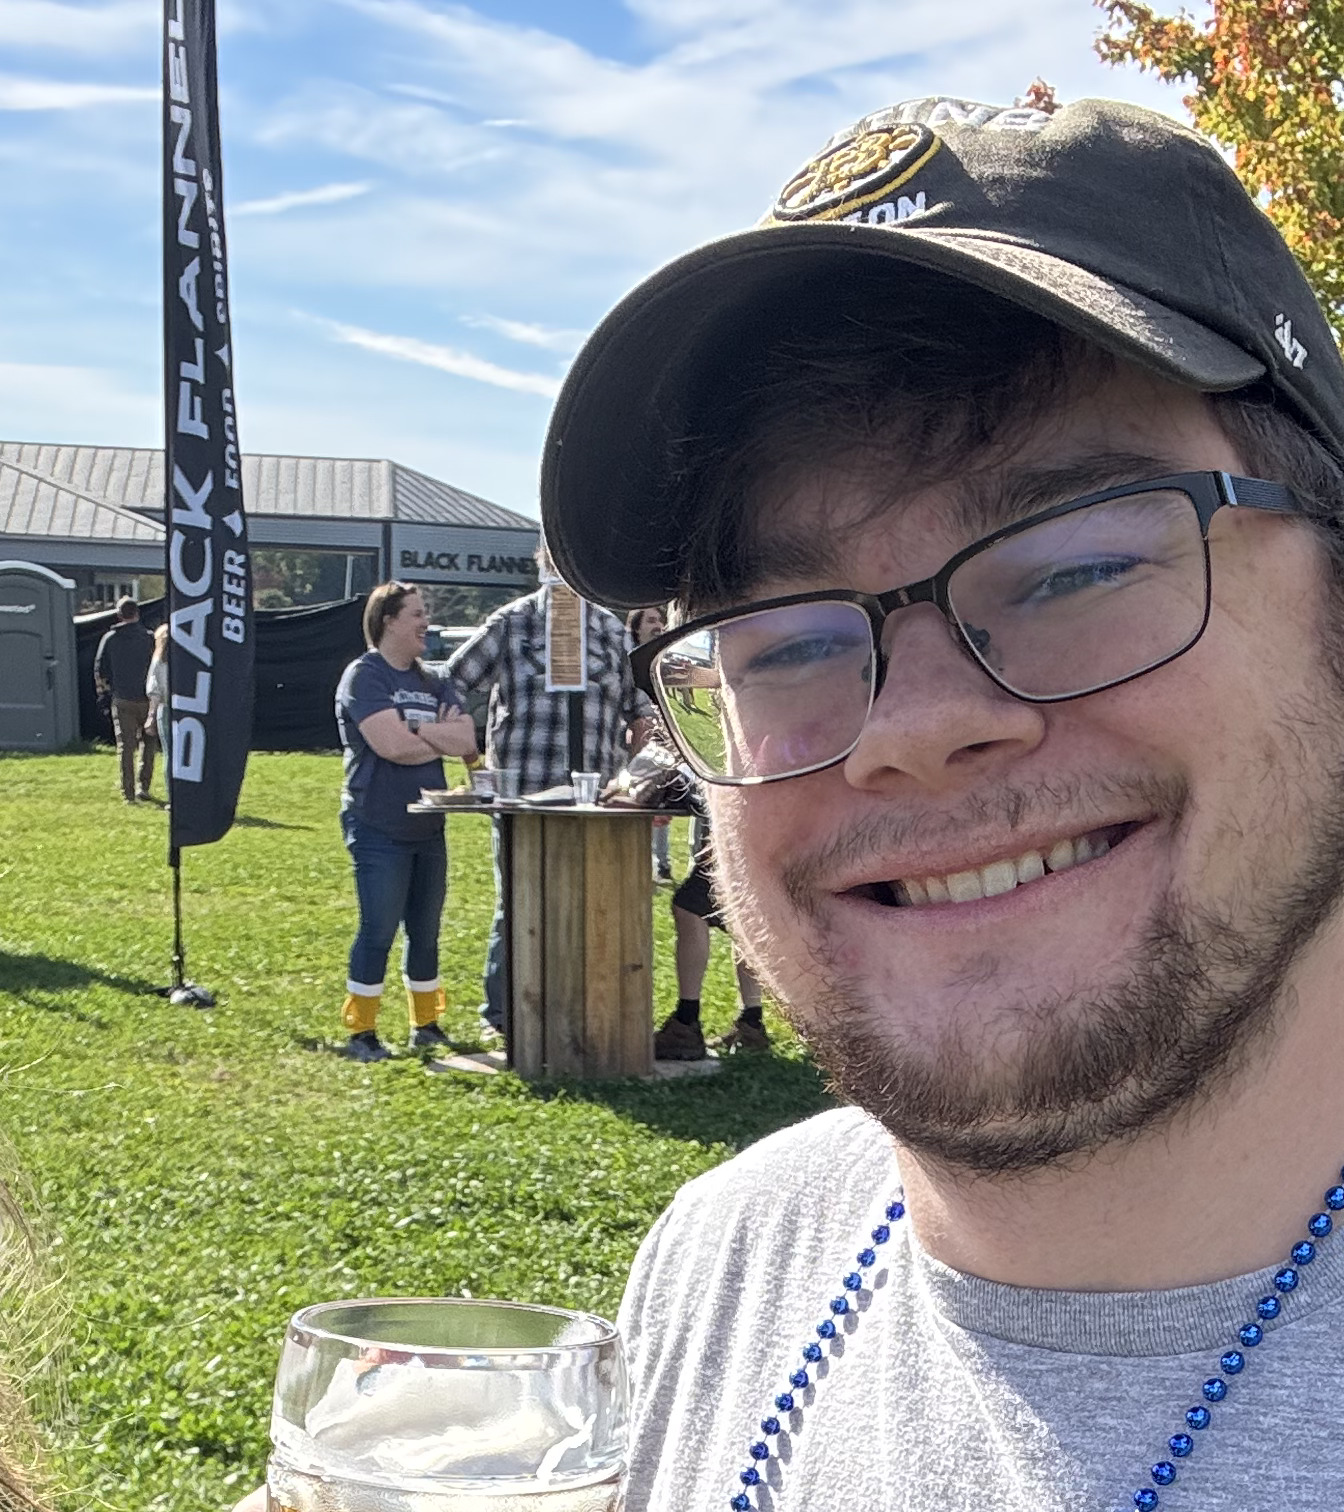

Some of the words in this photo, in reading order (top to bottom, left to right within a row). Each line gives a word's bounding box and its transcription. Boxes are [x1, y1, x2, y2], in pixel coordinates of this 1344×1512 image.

[221, 548, 247, 645] BEER
[399, 550, 460, 572] BLACK
[467, 554, 537, 574] FLANNE
[170, 463, 214, 783] BLACK
